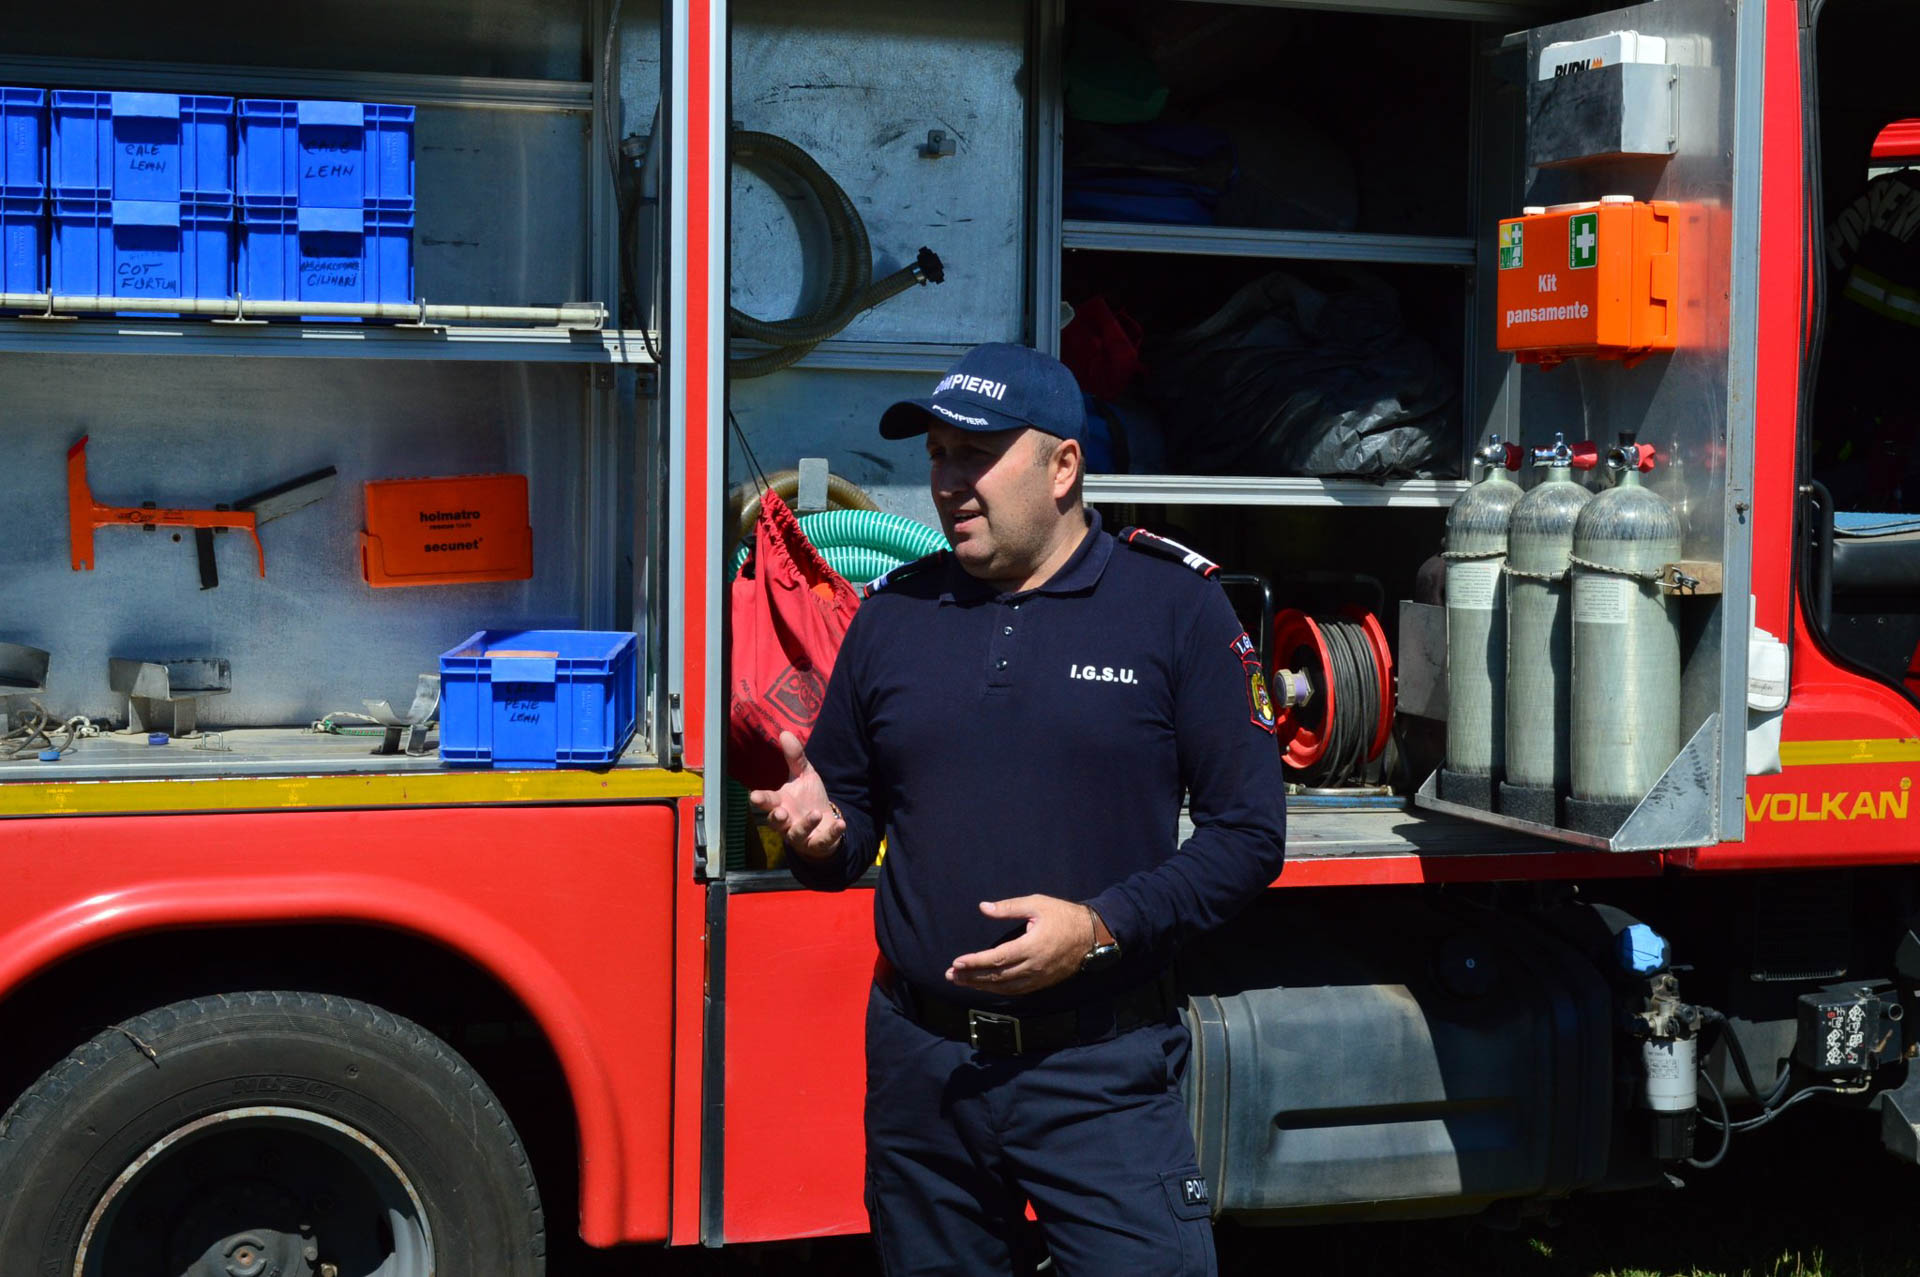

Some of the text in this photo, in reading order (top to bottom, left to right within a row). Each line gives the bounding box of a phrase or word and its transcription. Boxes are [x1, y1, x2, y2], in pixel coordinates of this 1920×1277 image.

[304, 164, 354, 178] LEMN
[117, 262, 163, 275] COT
[1538, 274, 1557, 292] Kit
[1506, 301, 1589, 328] pansamente
[424, 539, 480, 553] secunet
[1070, 664, 1138, 685] I.G.S.U.
[1745, 790, 1910, 822] VOLKAN
